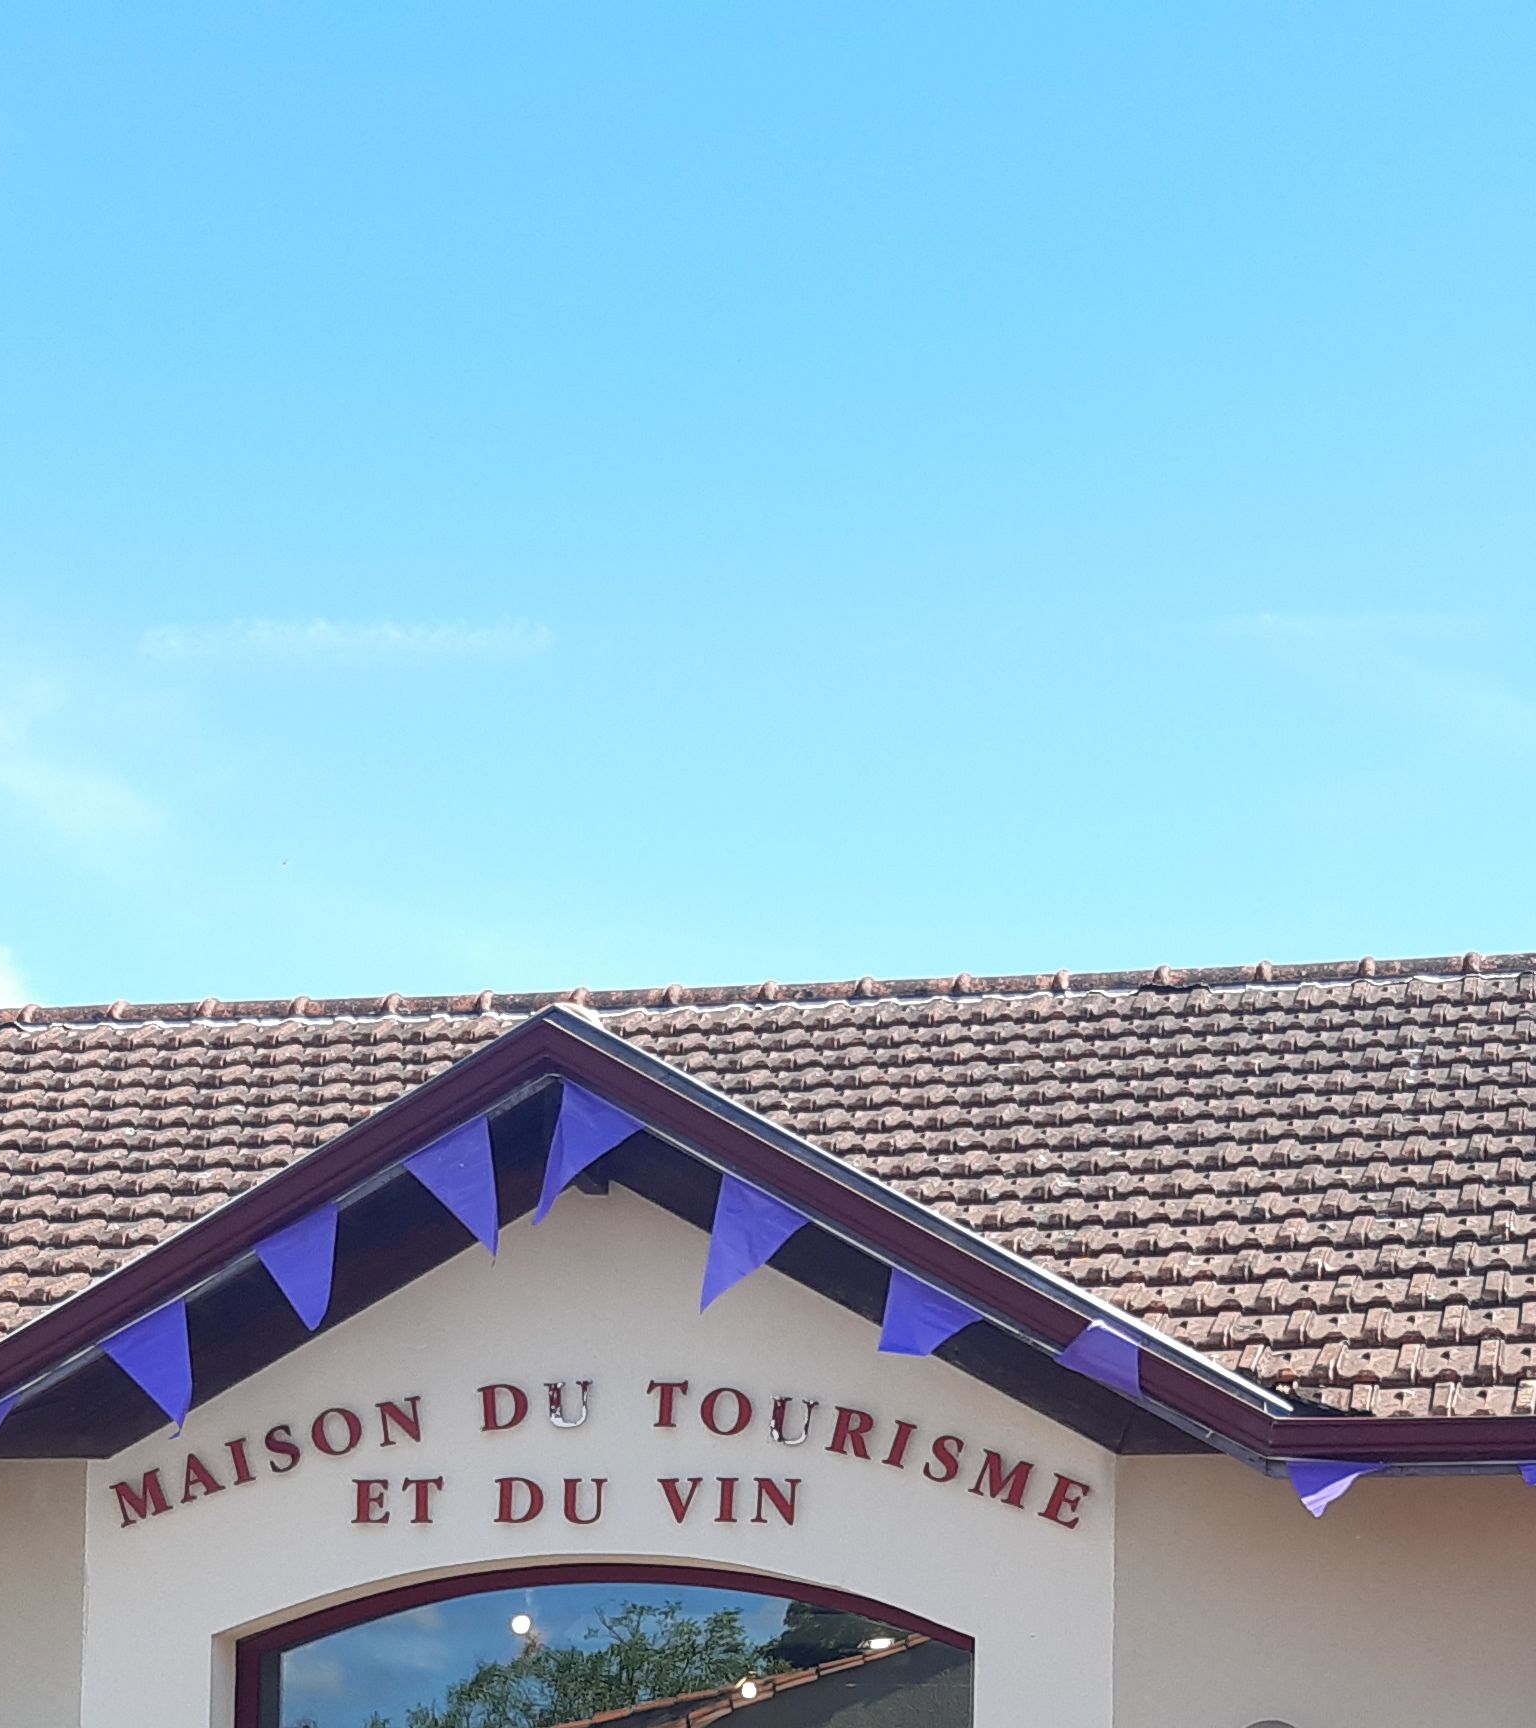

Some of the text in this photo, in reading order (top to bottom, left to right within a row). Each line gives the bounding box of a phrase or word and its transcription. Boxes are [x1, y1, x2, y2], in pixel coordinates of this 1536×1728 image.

[108, 1378, 1094, 1531] MAISON DU TOURISME
[350, 1476, 804, 1526] ET DU VIN
